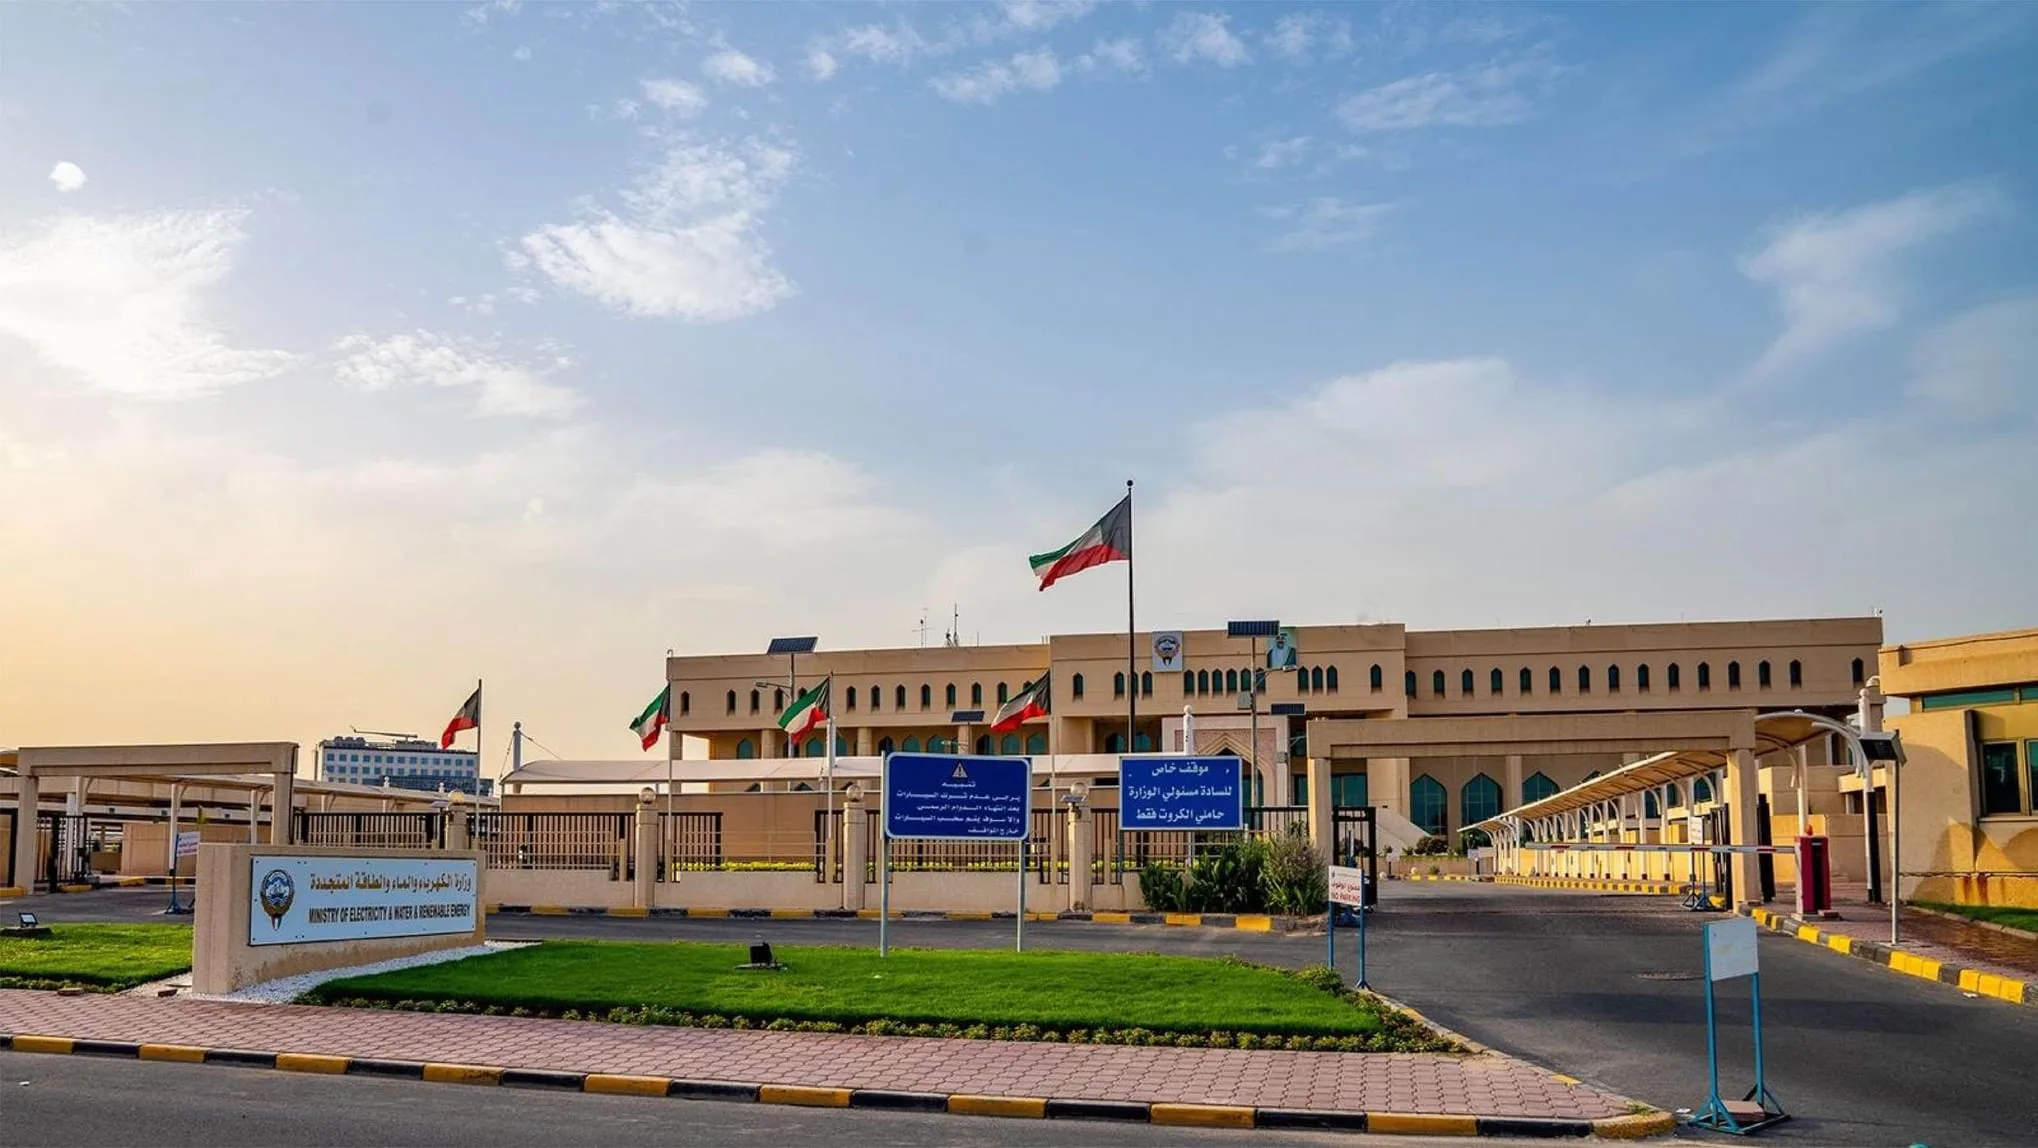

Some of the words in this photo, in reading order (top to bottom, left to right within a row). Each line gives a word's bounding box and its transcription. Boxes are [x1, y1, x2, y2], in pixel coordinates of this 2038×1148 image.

[1151, 761, 1177, 777] خاص
[1178, 761, 1209, 776] موقف
[1128, 785, 1161, 800] الوزارة
[1200, 785, 1233, 796] للسادة
[1135, 807, 1158, 820] فقط
[1158, 807, 1194, 823] الكروت
[1194, 808, 1225, 825] حاملي
[309, 872, 354, 894] المتجددة
[355, 871, 391, 893] والطاقة
[419, 872, 452, 894] الكهرباء
[454, 873, 472, 892] وزارة
[309, 907, 339, 924] MINISTRY
[340, 907, 349, 923] OF
[350, 906, 387, 922] ELECTRICITY
[388, 906, 393, 920] &
[394, 905, 413, 920] WATER
[413, 905, 418, 919] &
[419, 904, 450, 919] RENEWABLE
[451, 903, 471, 917] ENERGY
